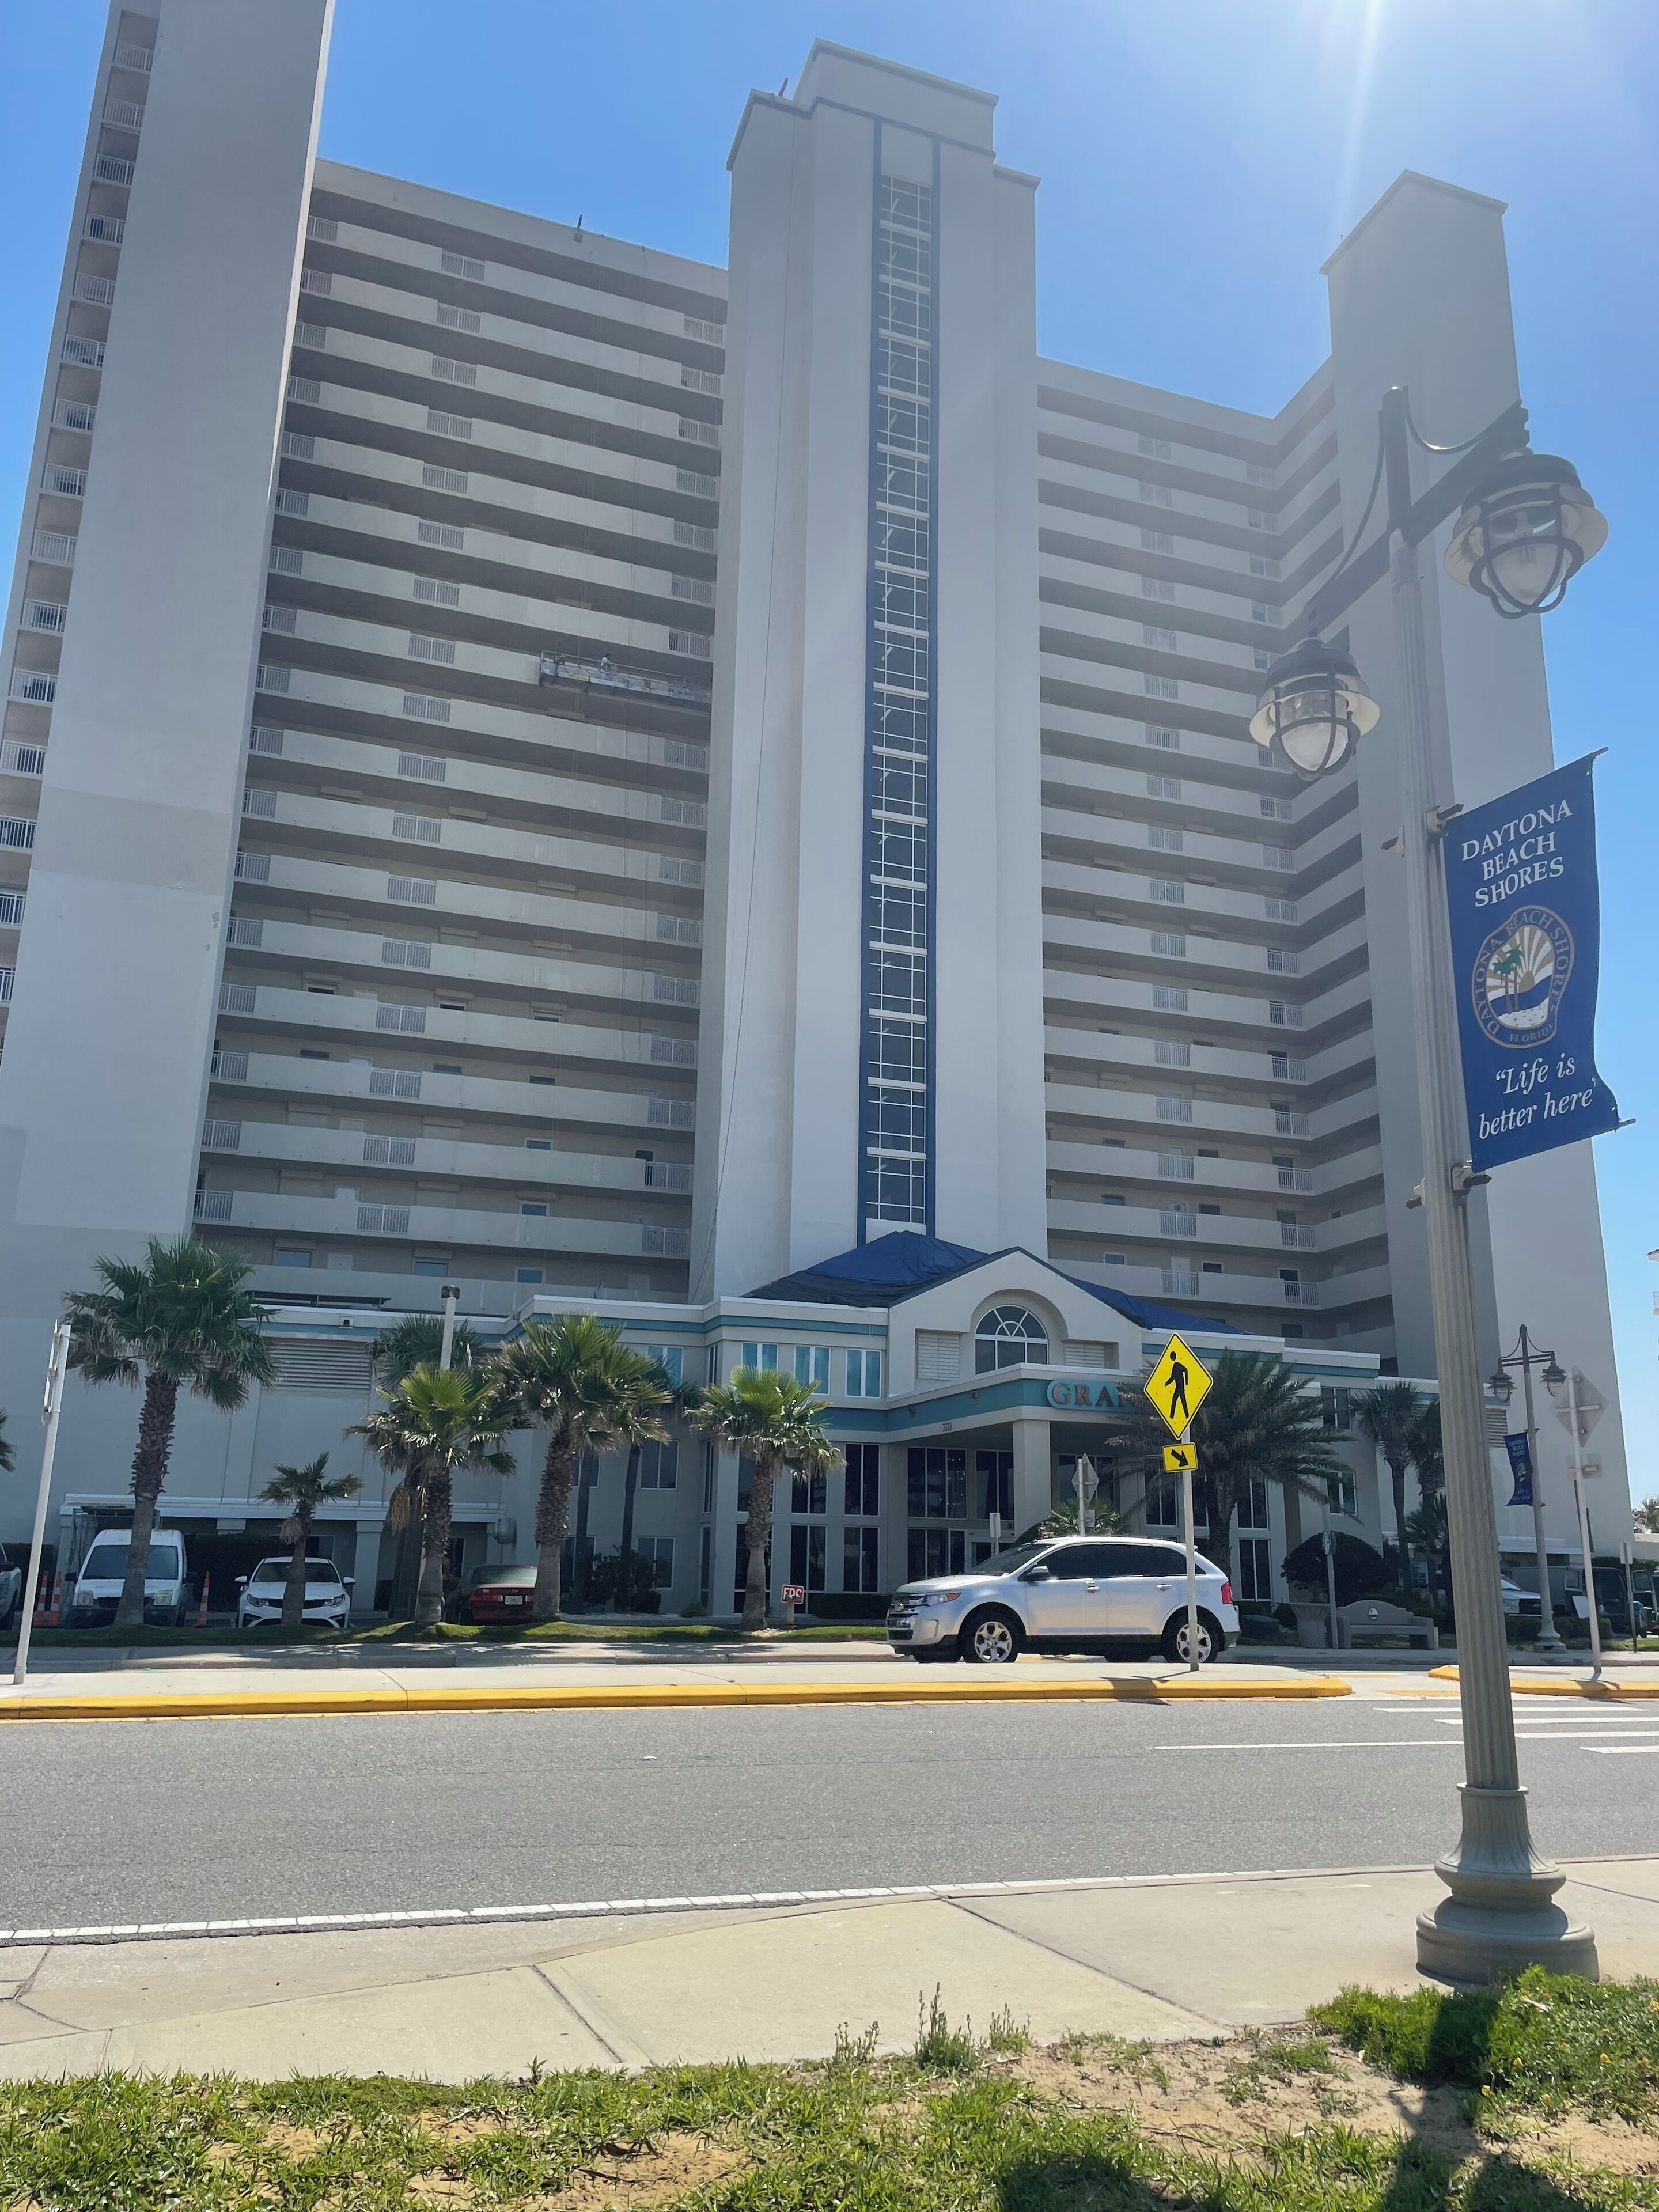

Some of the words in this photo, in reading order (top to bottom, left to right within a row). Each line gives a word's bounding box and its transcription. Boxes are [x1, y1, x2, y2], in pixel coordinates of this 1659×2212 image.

[1461, 799, 1573, 861] DAYTONA
[1481, 831, 1557, 881] BEACH
[1475, 856, 1565, 907] SHORES
[1474, 937, 1504, 1037] DAYTONA
[1504, 910, 1554, 937] BEACH
[1548, 926, 1570, 1016] SHORES
[1509, 1023, 1554, 1043] FLORIDA
[1495, 1057, 1549, 1095] “Life
[1556, 1052, 1576, 1078] is
[1478, 1104, 1539, 1139] better
